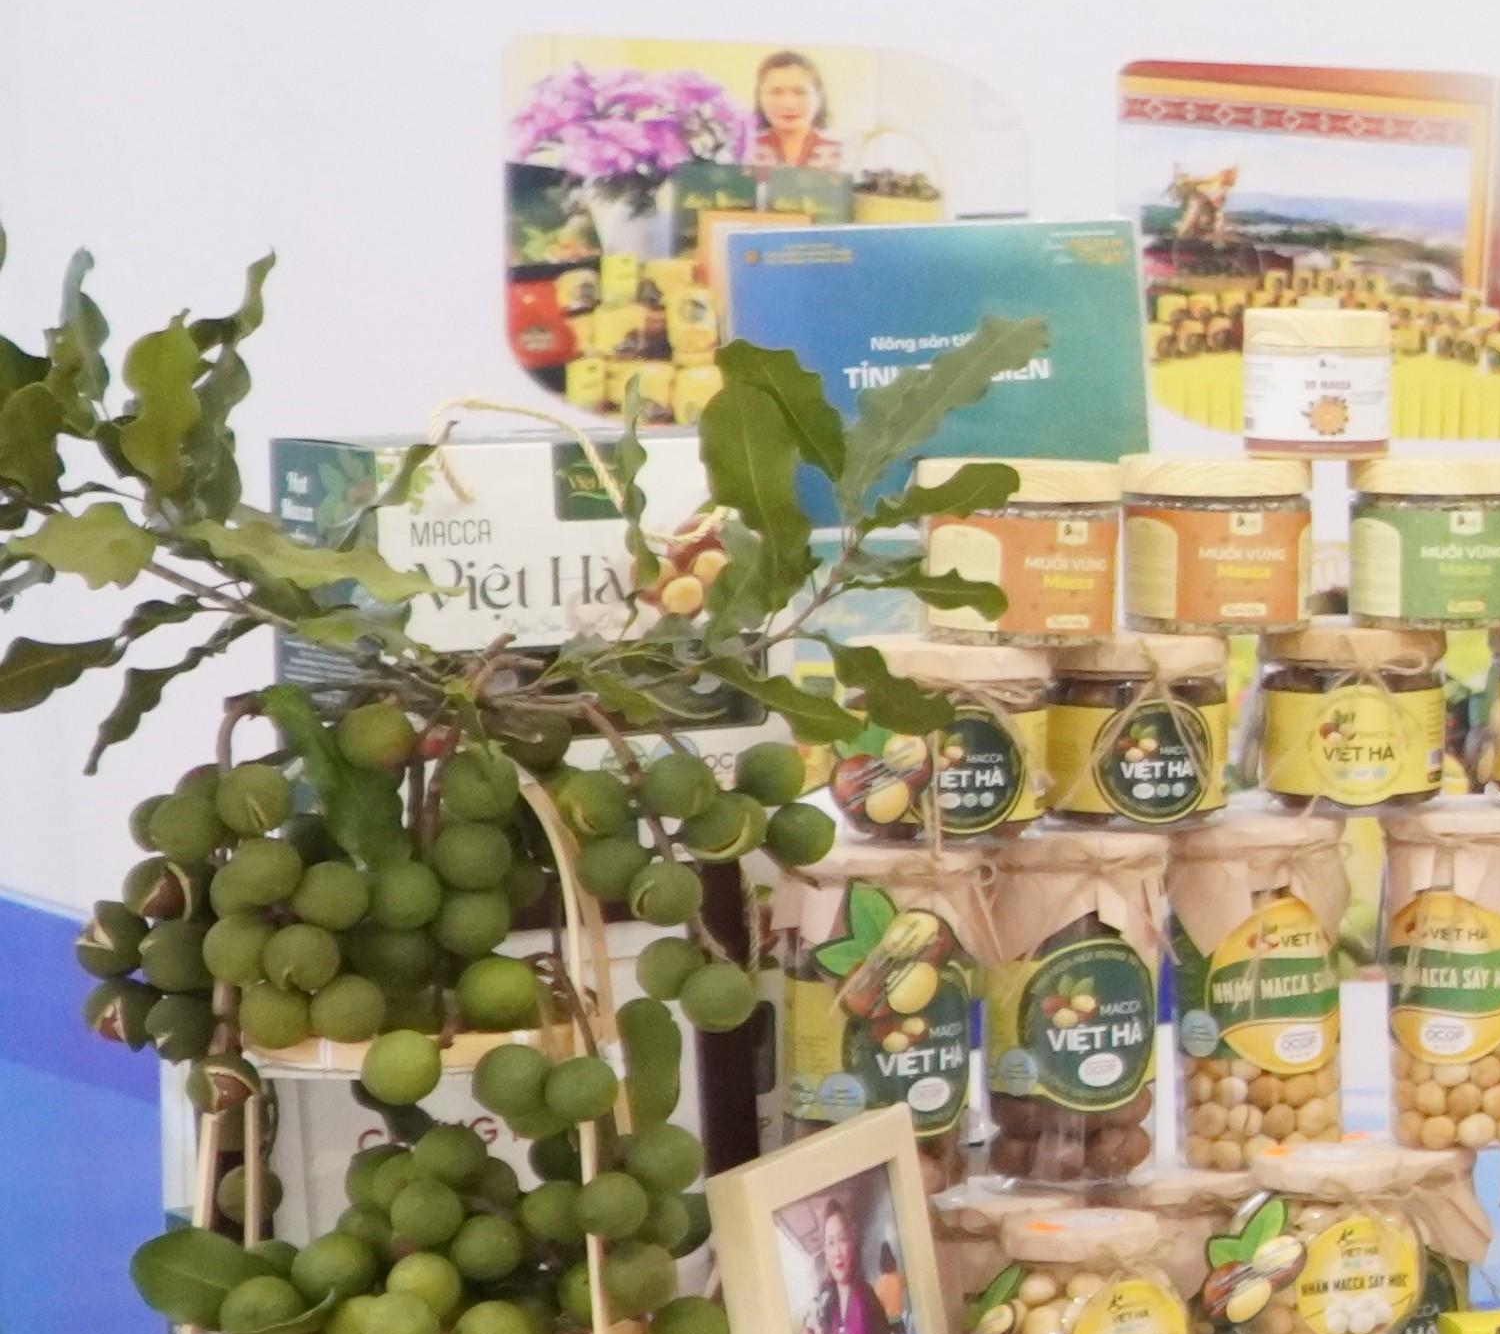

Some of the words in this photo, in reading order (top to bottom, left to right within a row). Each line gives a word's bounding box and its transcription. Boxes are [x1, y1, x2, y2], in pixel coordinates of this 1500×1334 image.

[870, 336, 917, 353] Nông
[410, 518, 492, 548] MACCA
[550, 555, 631, 608] Hà
[1260, 976, 1309, 1000] MACCA
[1421, 968, 1459, 988] ACCA
[1046, 1025, 1106, 1055] VIỆT
